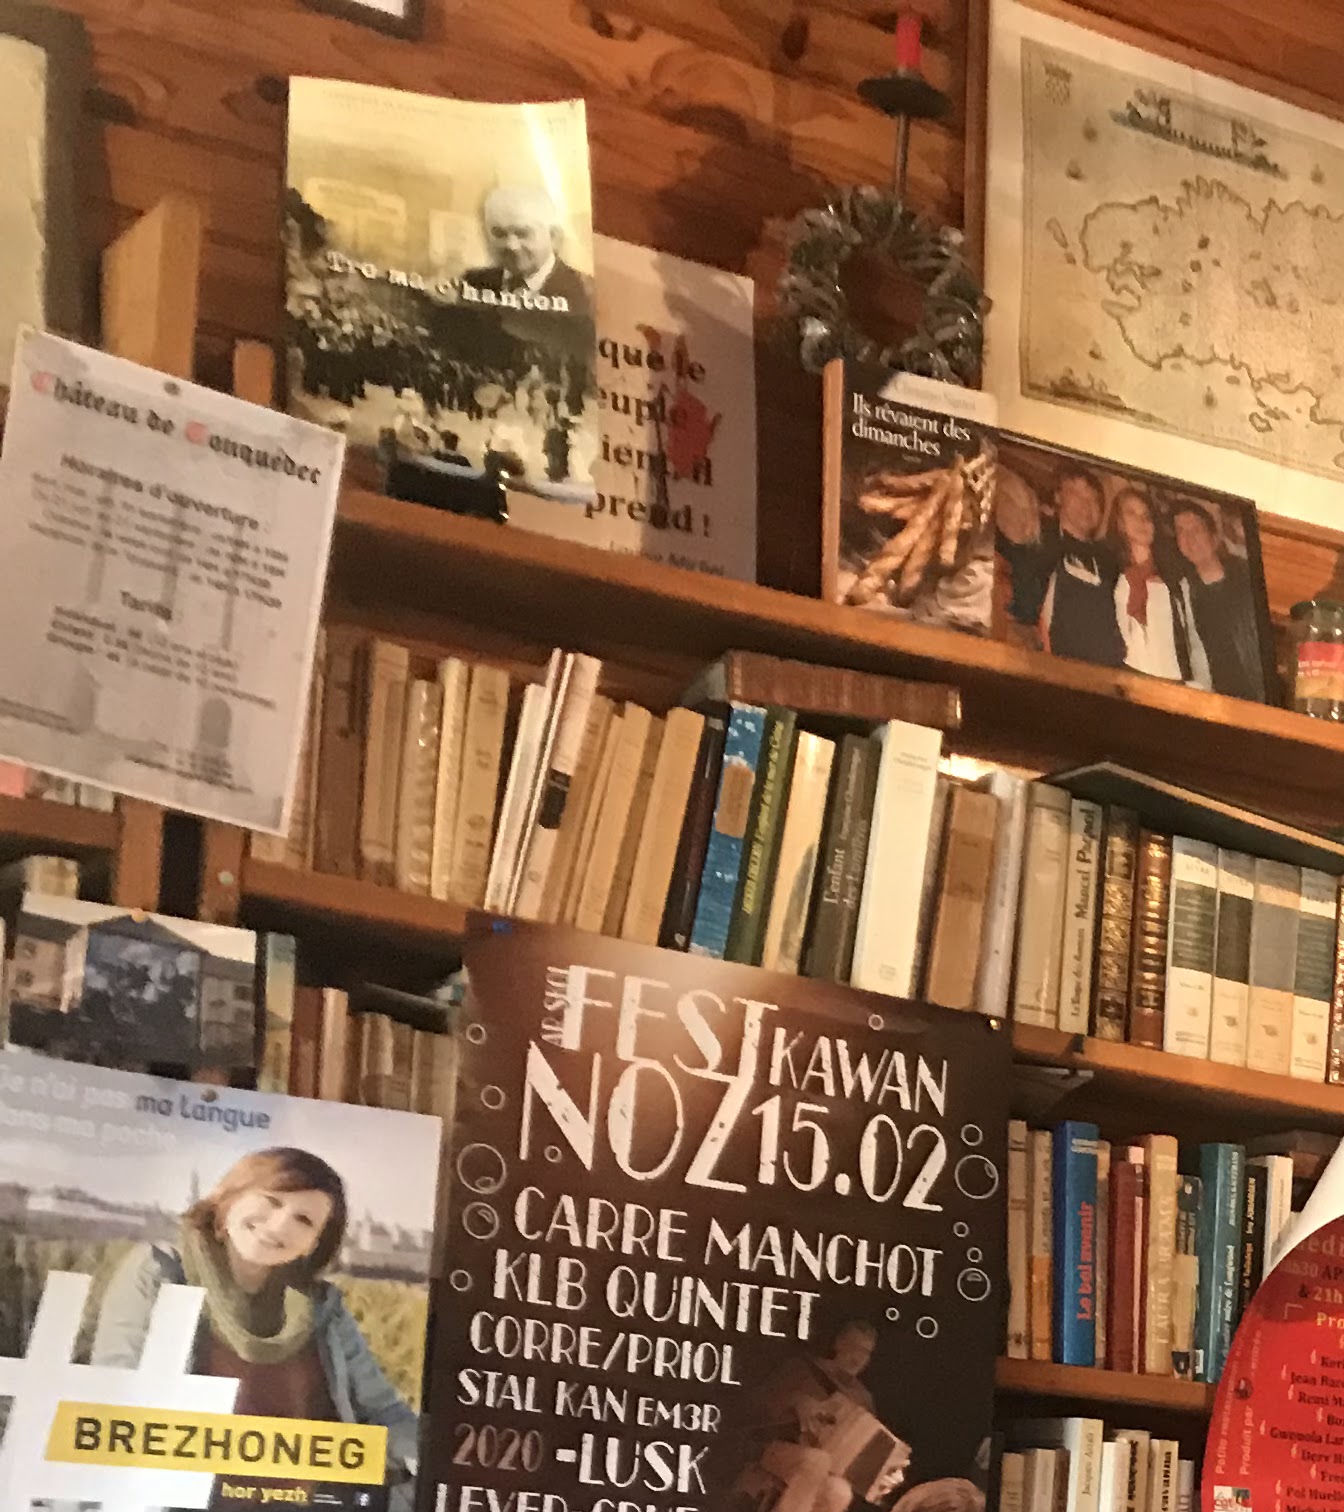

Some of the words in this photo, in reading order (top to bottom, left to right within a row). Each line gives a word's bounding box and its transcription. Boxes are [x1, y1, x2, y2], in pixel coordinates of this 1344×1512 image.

[599, 338, 666, 375] que
[852, 415, 941, 456] dimanches
[853, 392, 872, 417] Ils
[875, 402, 940, 434] rêvaient
[942, 417, 971, 441] des
[561, 964, 779, 1080] FEST
[769, 1027, 948, 1117] KAWAN
[135, 1095, 174, 1117] ma
[180, 1095, 272, 1132] langue
[518, 1040, 755, 1194] NOZ
[751, 1094, 948, 1212] 15.02
[514, 1186, 689, 1263] CARRE
[704, 1217, 943, 1297] MANCHOT
[493, 1248, 587, 1312] KLB
[606, 1264, 821, 1341] QUINTET
[456, 1368, 542, 1415] STAL
[555, 1379, 628, 1425] KAN
[73, 1416, 367, 1470] BREZHONEG
[453, 1422, 543, 1472] 2020
